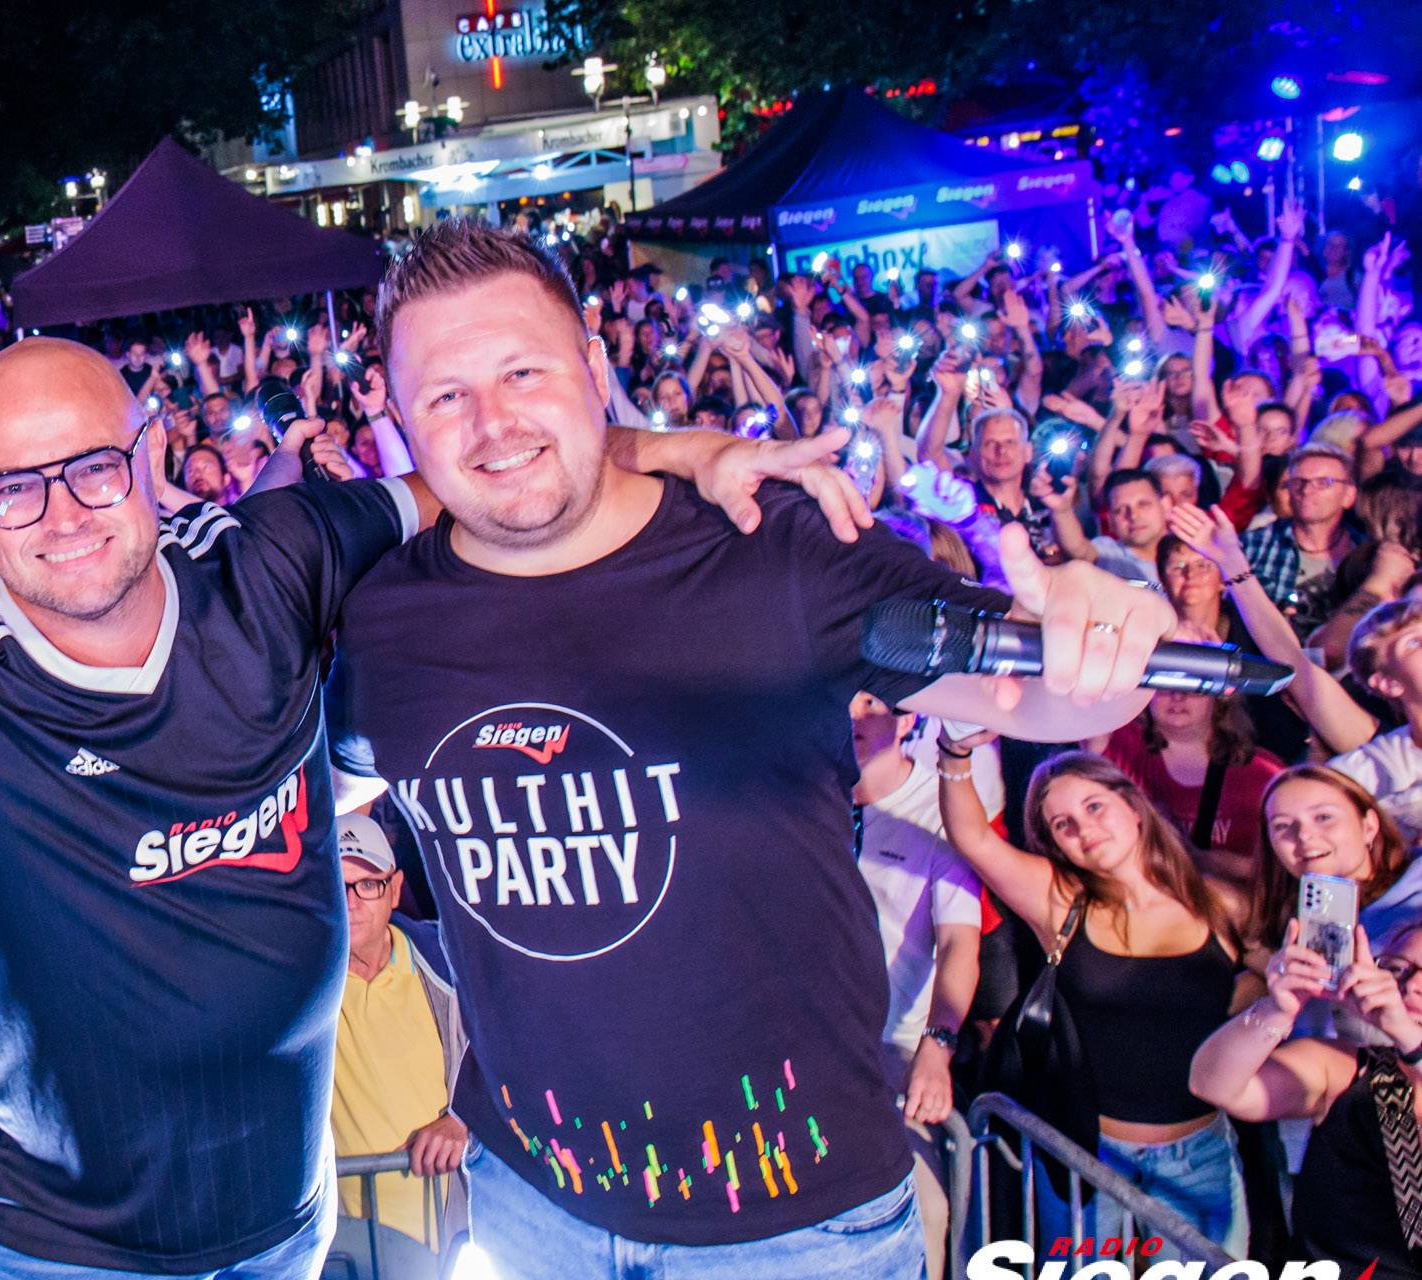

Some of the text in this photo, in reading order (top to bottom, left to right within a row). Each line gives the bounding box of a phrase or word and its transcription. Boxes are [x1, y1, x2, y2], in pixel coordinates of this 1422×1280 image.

[370, 153, 434, 174] Krombacher
[474, 724, 563, 748] Siegen
[168, 810, 238, 837] RADIO
[397, 762, 681, 835] KULTHIT
[128, 773, 299, 882] Siegen
[455, 831, 640, 906] PARTY
